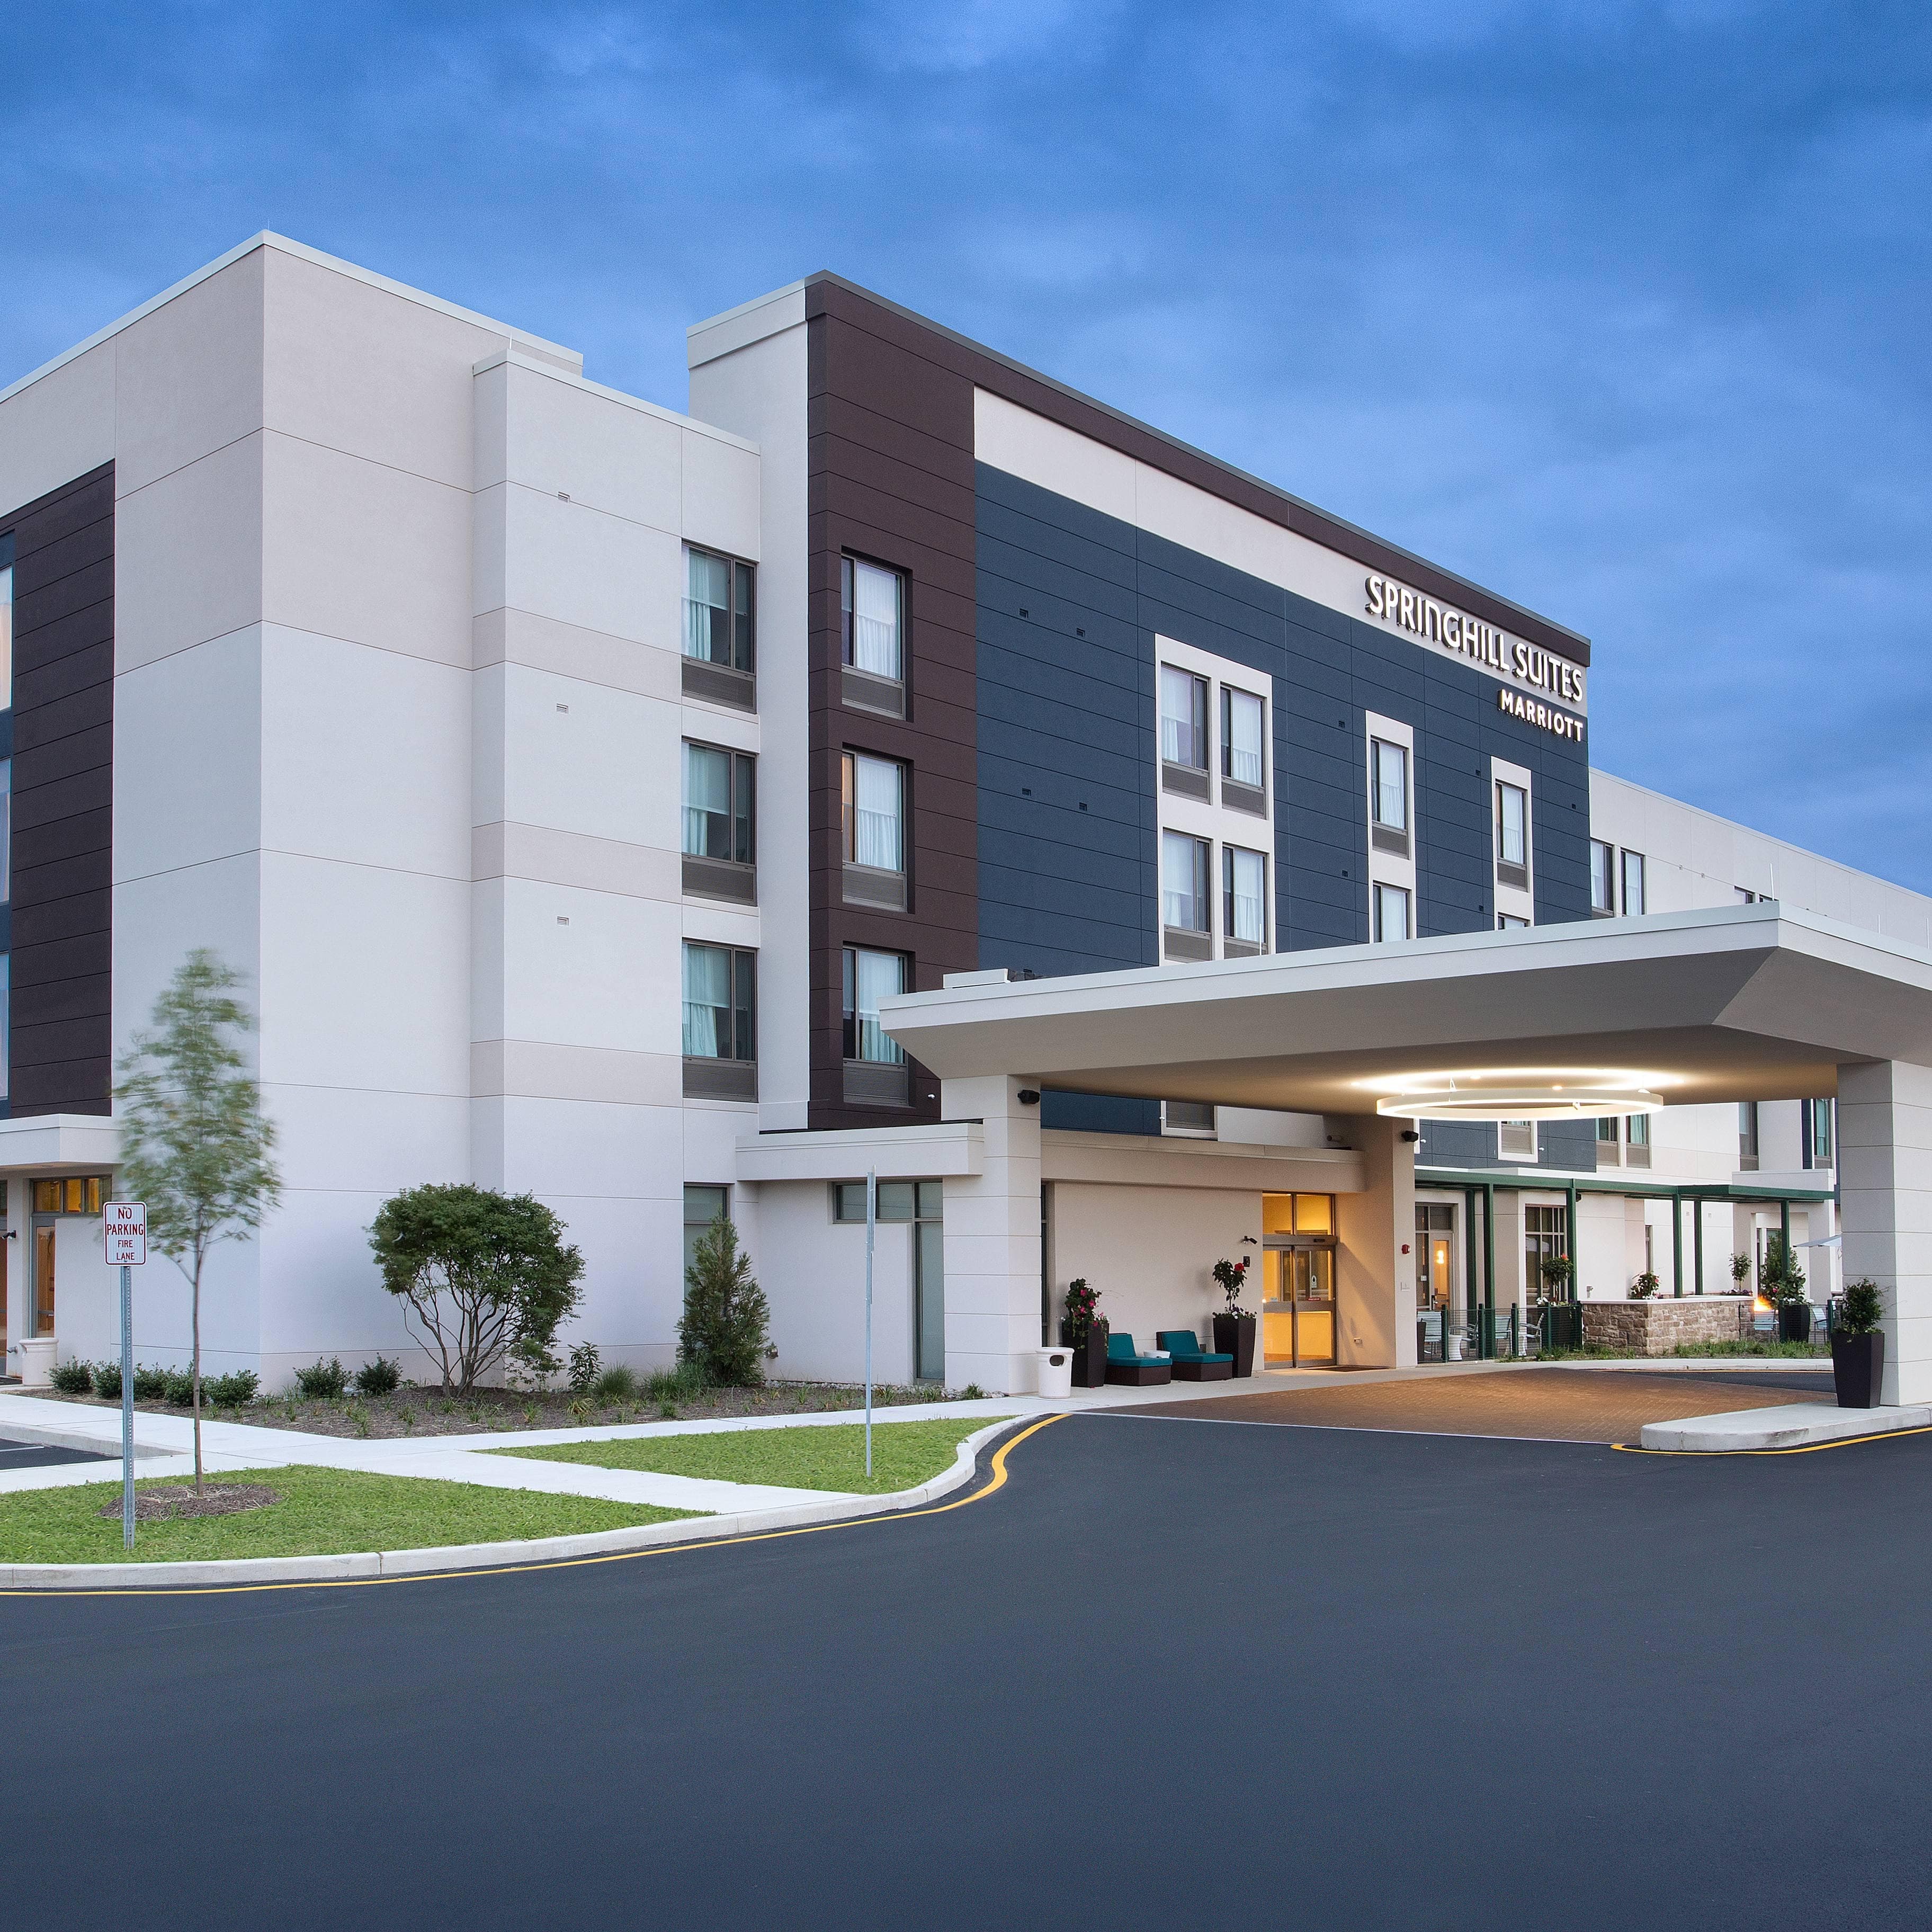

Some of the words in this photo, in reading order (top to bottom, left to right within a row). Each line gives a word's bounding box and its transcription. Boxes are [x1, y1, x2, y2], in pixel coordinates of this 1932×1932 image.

[1365, 575, 1510, 672] SPRINGHILL
[1513, 642, 1583, 702] SUITES
[1499, 688, 1584, 742] MARRIOTT
[118, 1208, 132, 1219] NO
[107, 1224, 144, 1236] PARKING
[117, 1252, 135, 1260] LANE
